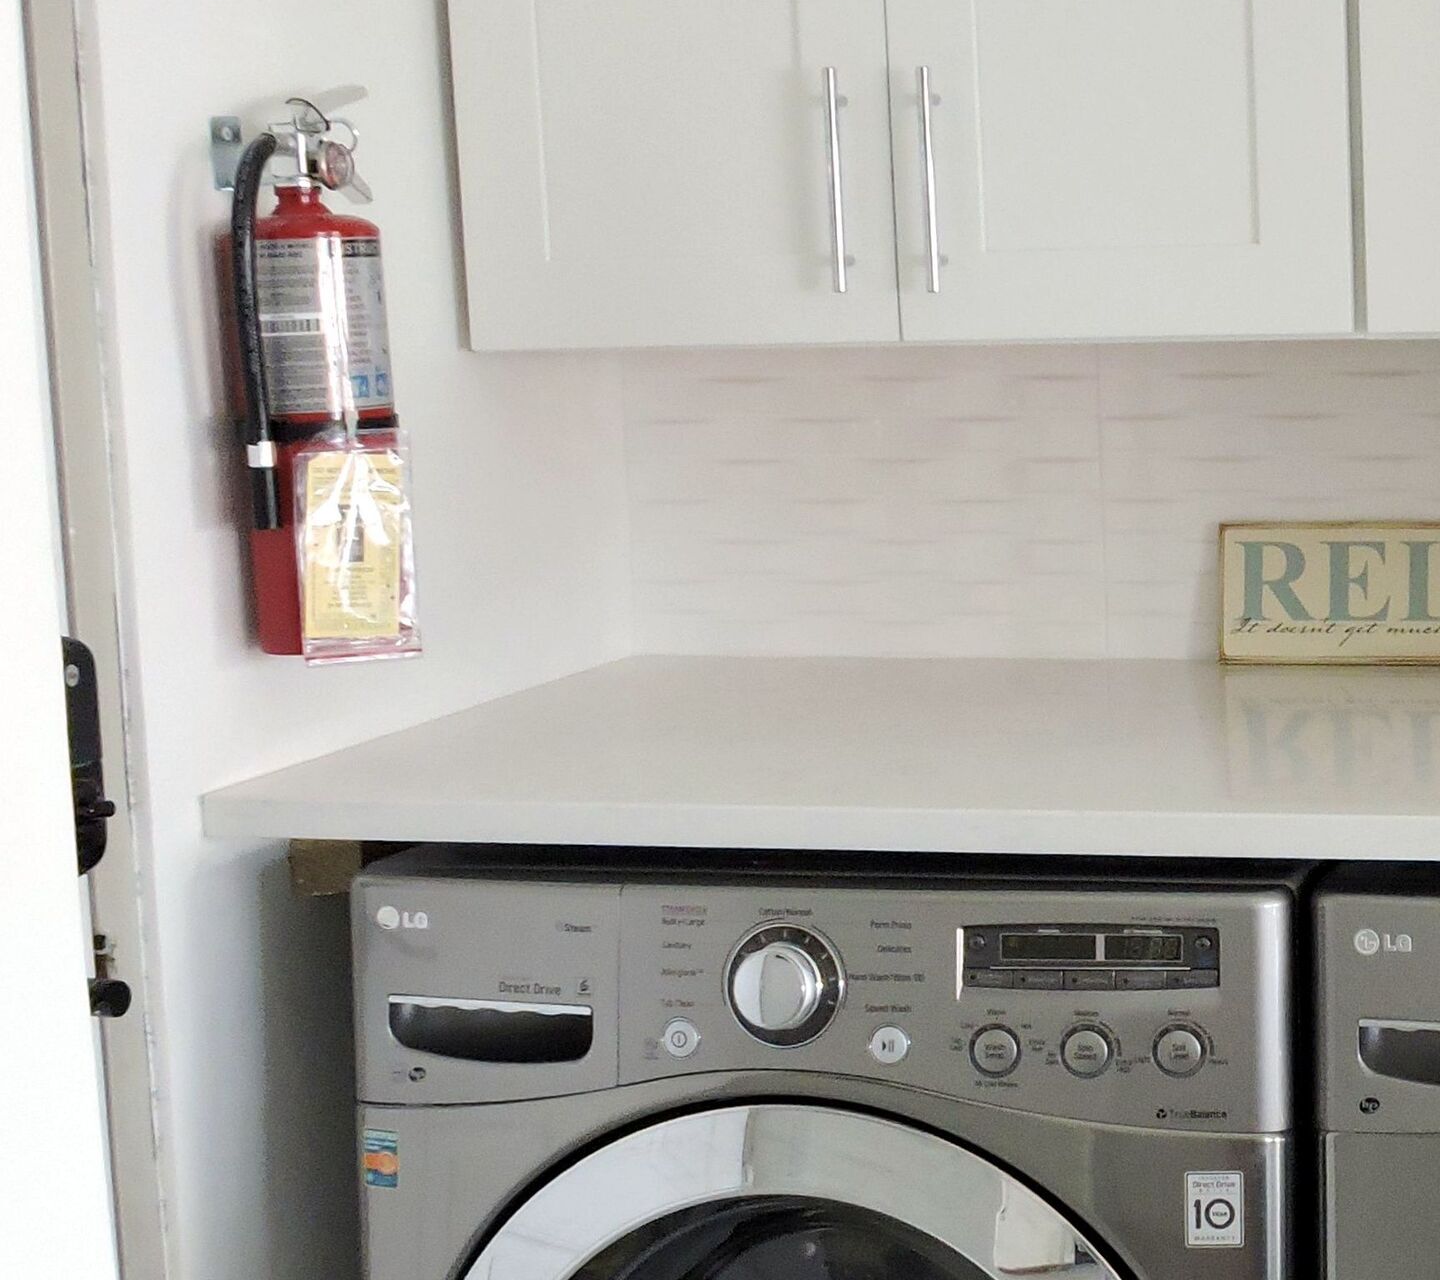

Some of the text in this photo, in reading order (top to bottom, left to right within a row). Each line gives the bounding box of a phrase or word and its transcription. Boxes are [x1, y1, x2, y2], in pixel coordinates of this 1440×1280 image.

[1265, 618, 1337, 637] doesn't
[1338, 622, 1372, 647] get
[402, 911, 428, 929] LG
[1383, 933, 1412, 952] LG
[498, 980, 562, 996] Direct Drive
[1193, 1198, 1236, 1230] 10
